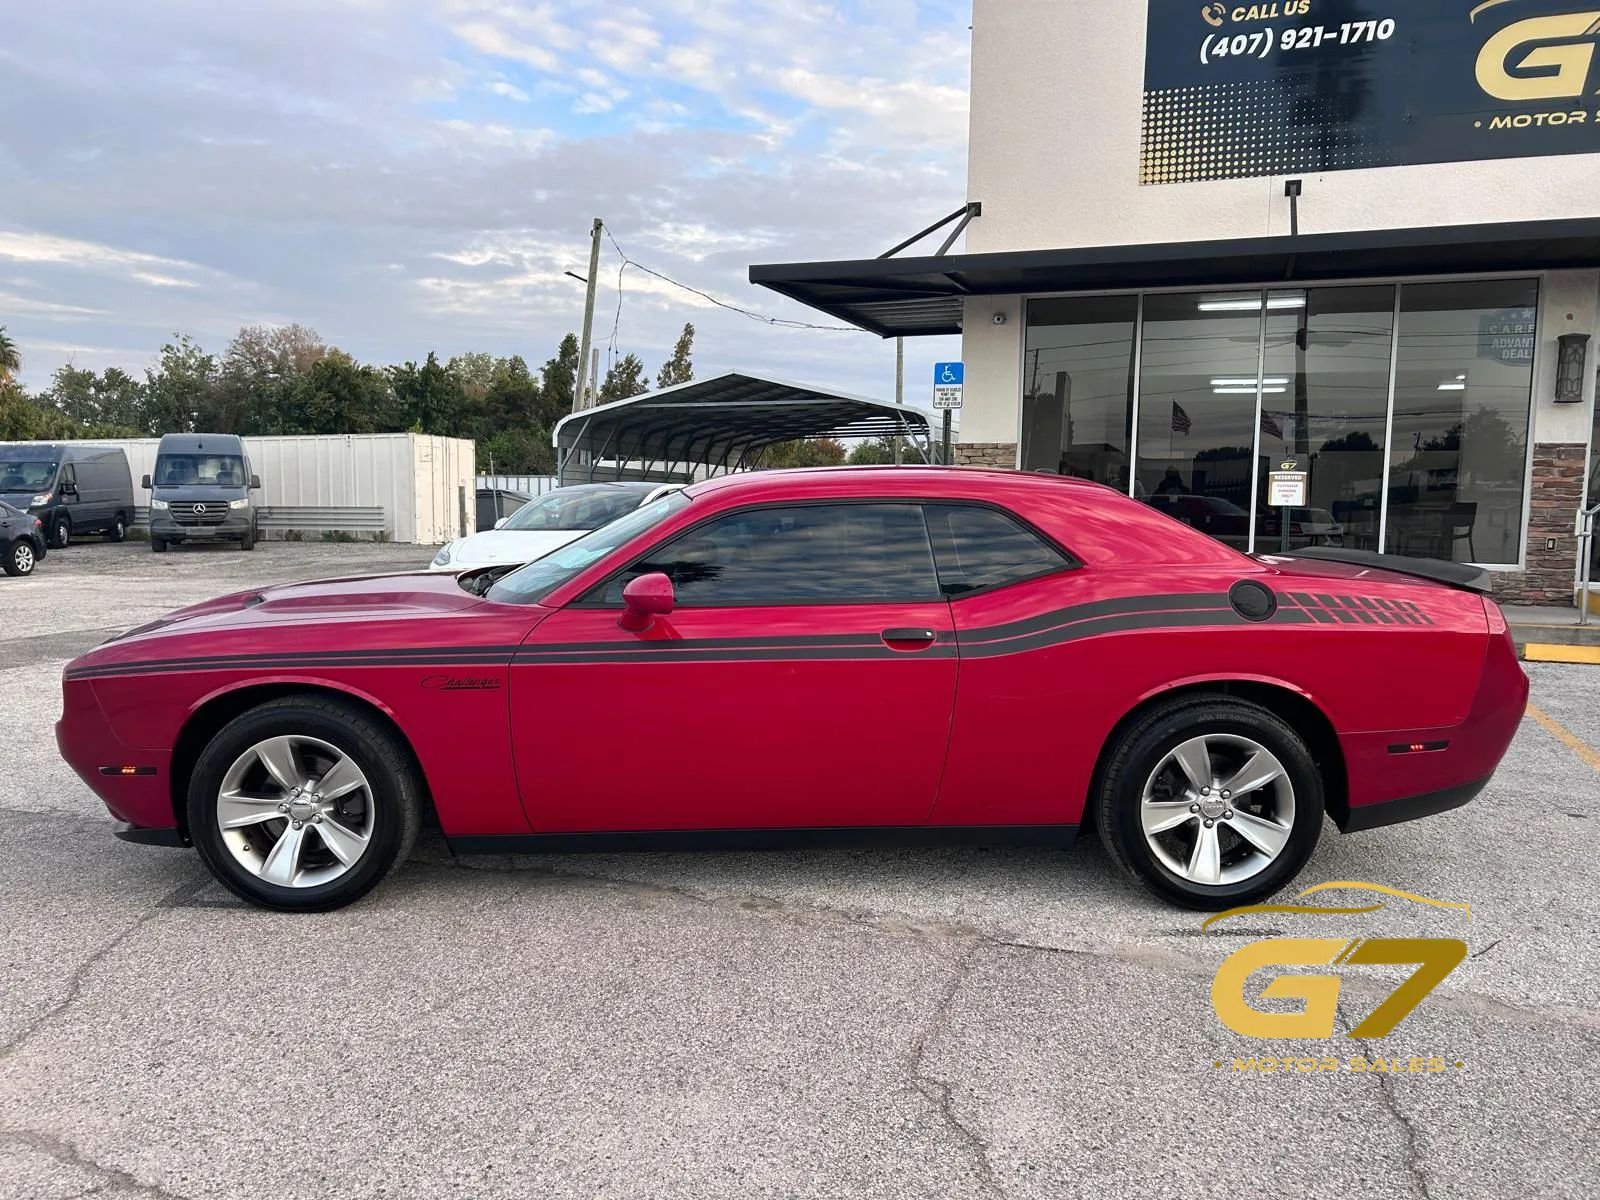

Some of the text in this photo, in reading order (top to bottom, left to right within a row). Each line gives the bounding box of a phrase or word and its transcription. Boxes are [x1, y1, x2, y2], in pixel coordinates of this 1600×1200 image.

[1231, 0, 1311, 22] CALL US
[1200, 18, 1396, 64] (407) 921-1710
[1475, 10, 1600, 101] G
[1488, 110, 1588, 130] MOTOR
[1502, 349, 1533, 359] DEAL
[1281, 462, 1298, 470] G7
[420, 674, 501, 690] Challenger
